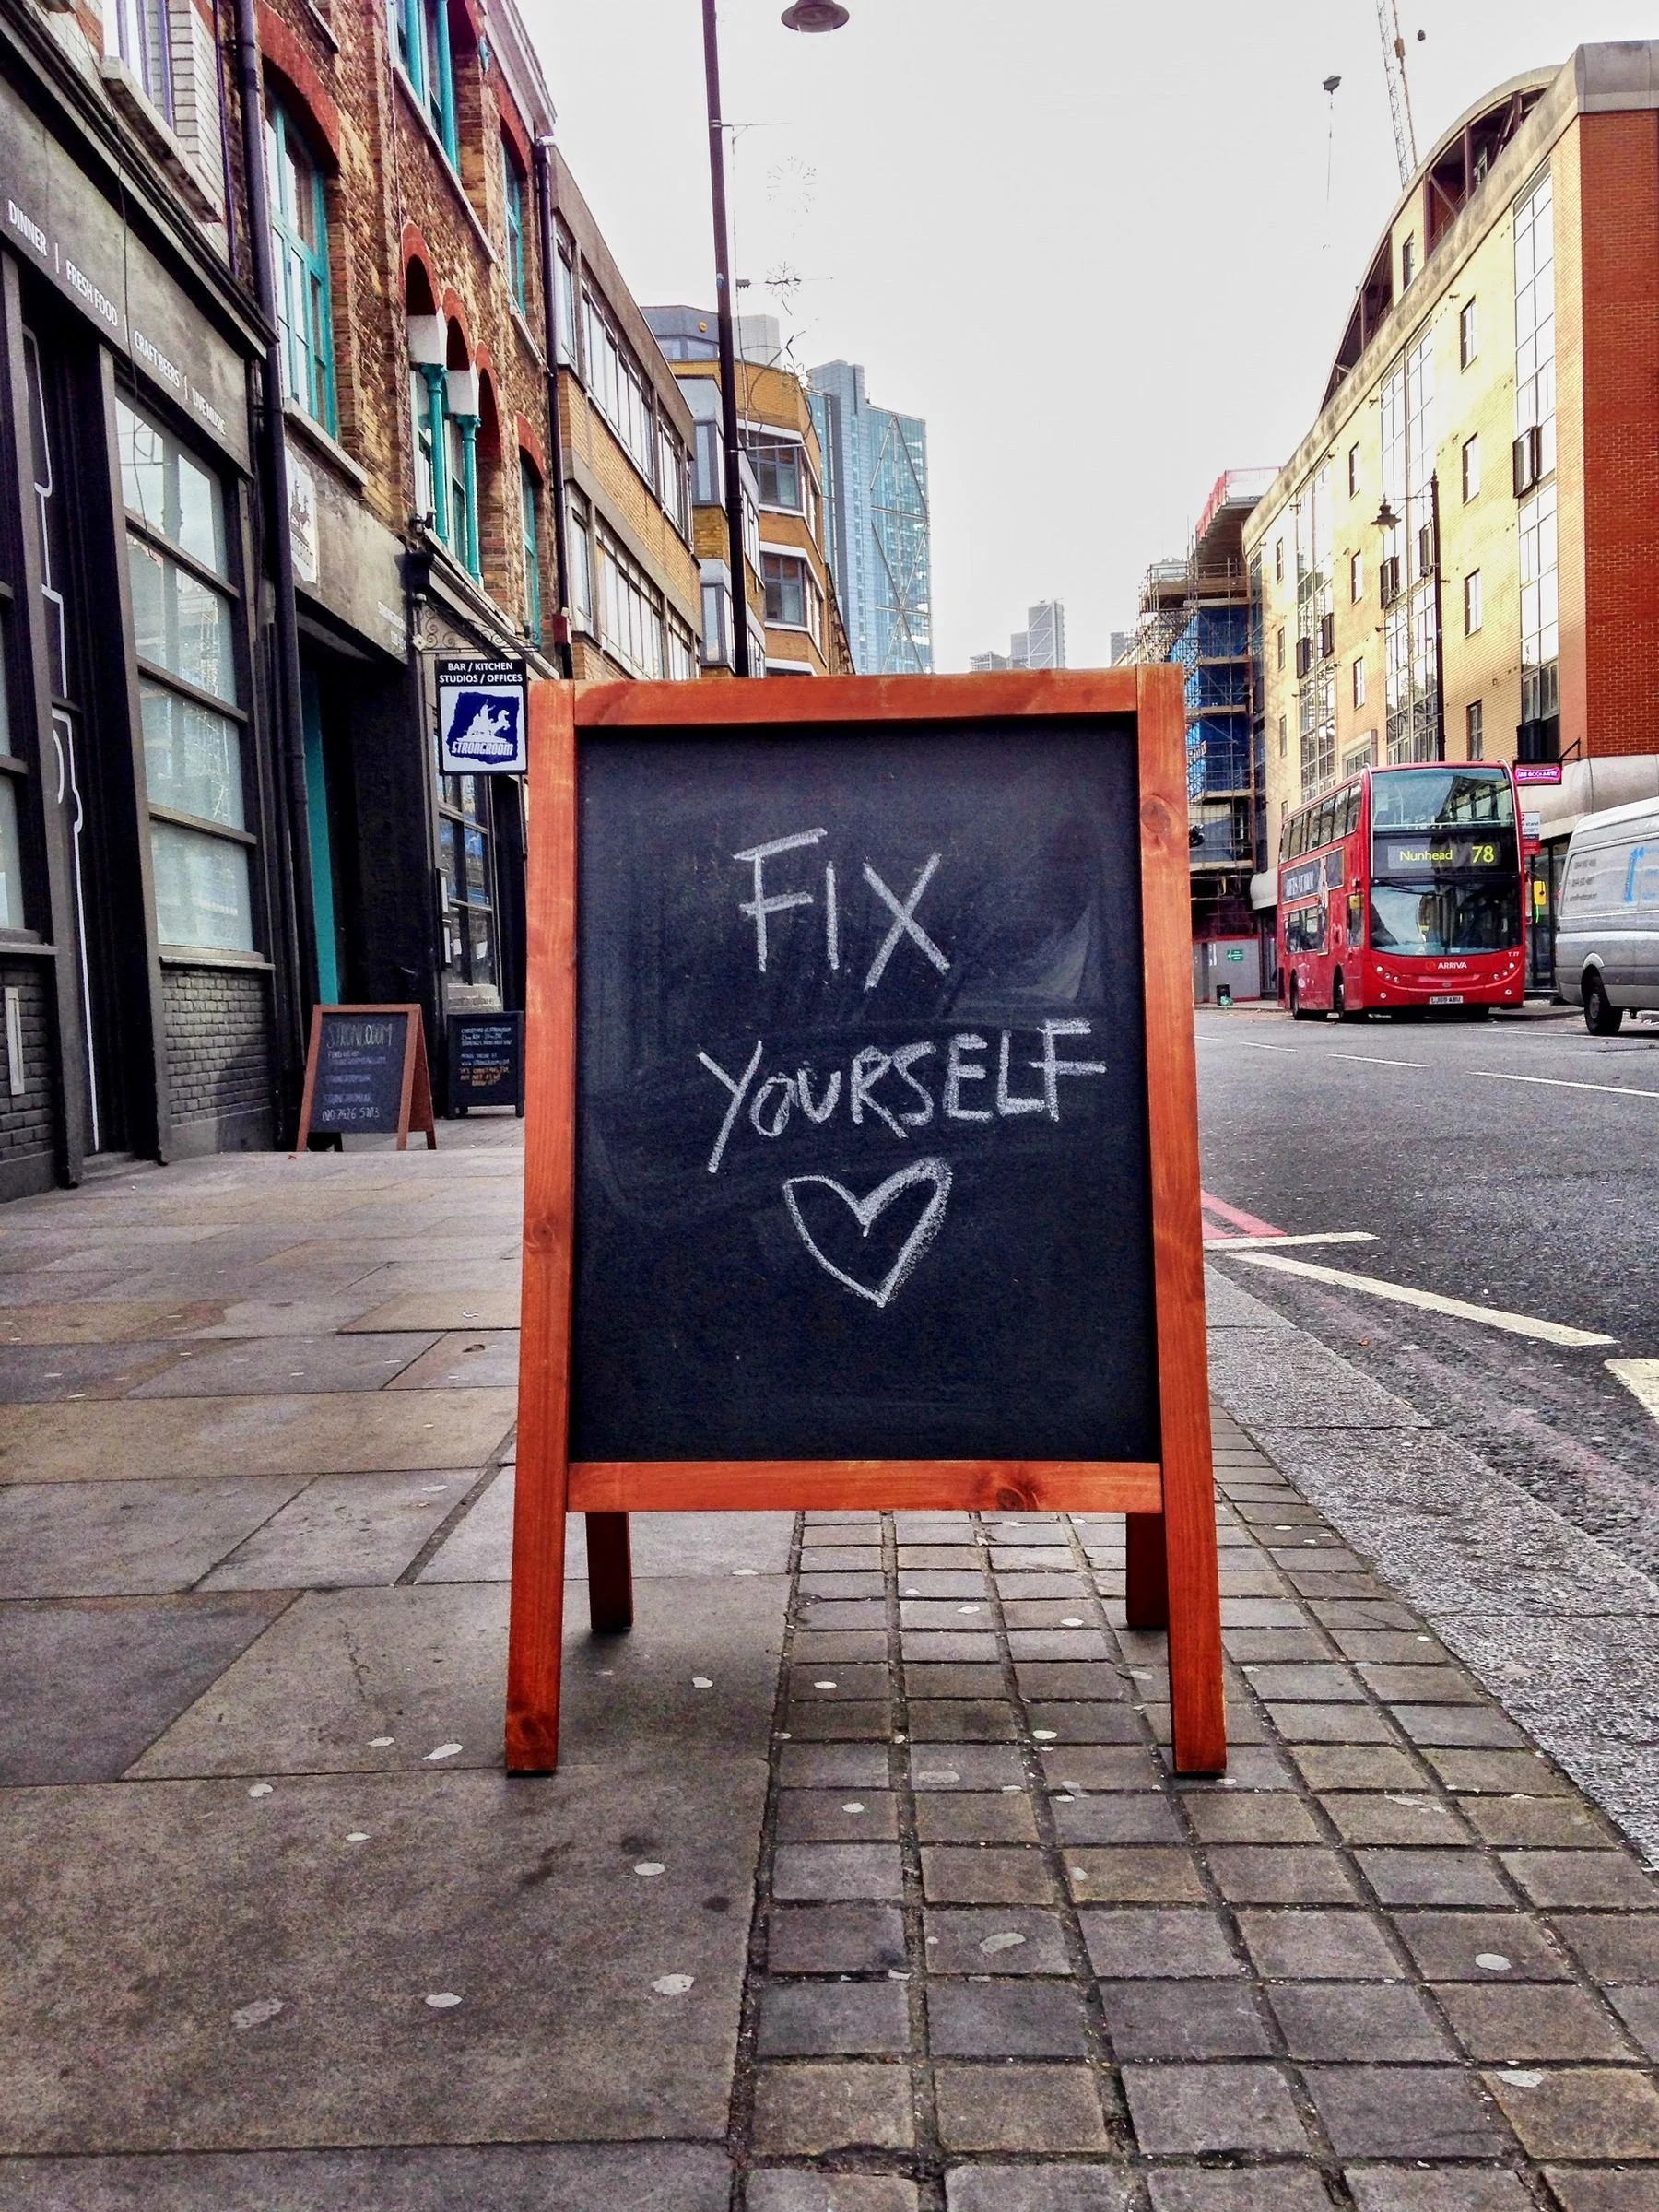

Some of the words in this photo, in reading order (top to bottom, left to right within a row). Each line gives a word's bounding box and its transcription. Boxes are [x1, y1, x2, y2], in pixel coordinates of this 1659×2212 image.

[8, 199, 48, 257] DINNER
[66, 259, 94, 303] FRESH
[94, 288, 118, 326] FOOD
[135, 330, 158, 367] CRAFT
[159, 354, 180, 388] BEERS
[448, 663, 465, 671] BAR
[467, 662, 473, 672] /
[475, 662, 513, 671] KITCHEN
[439, 675, 478, 683] STUDIOS
[480, 674, 485, 684] /
[487, 674, 523, 682] OFFICES
[451, 741, 513, 756] STRONGROOM
[1400, 850, 1453, 861] Nunhead
[1472, 845, 1495, 863] 78
[733, 827, 950, 993] FIX
[1438, 961, 1467, 970] ARRIVA
